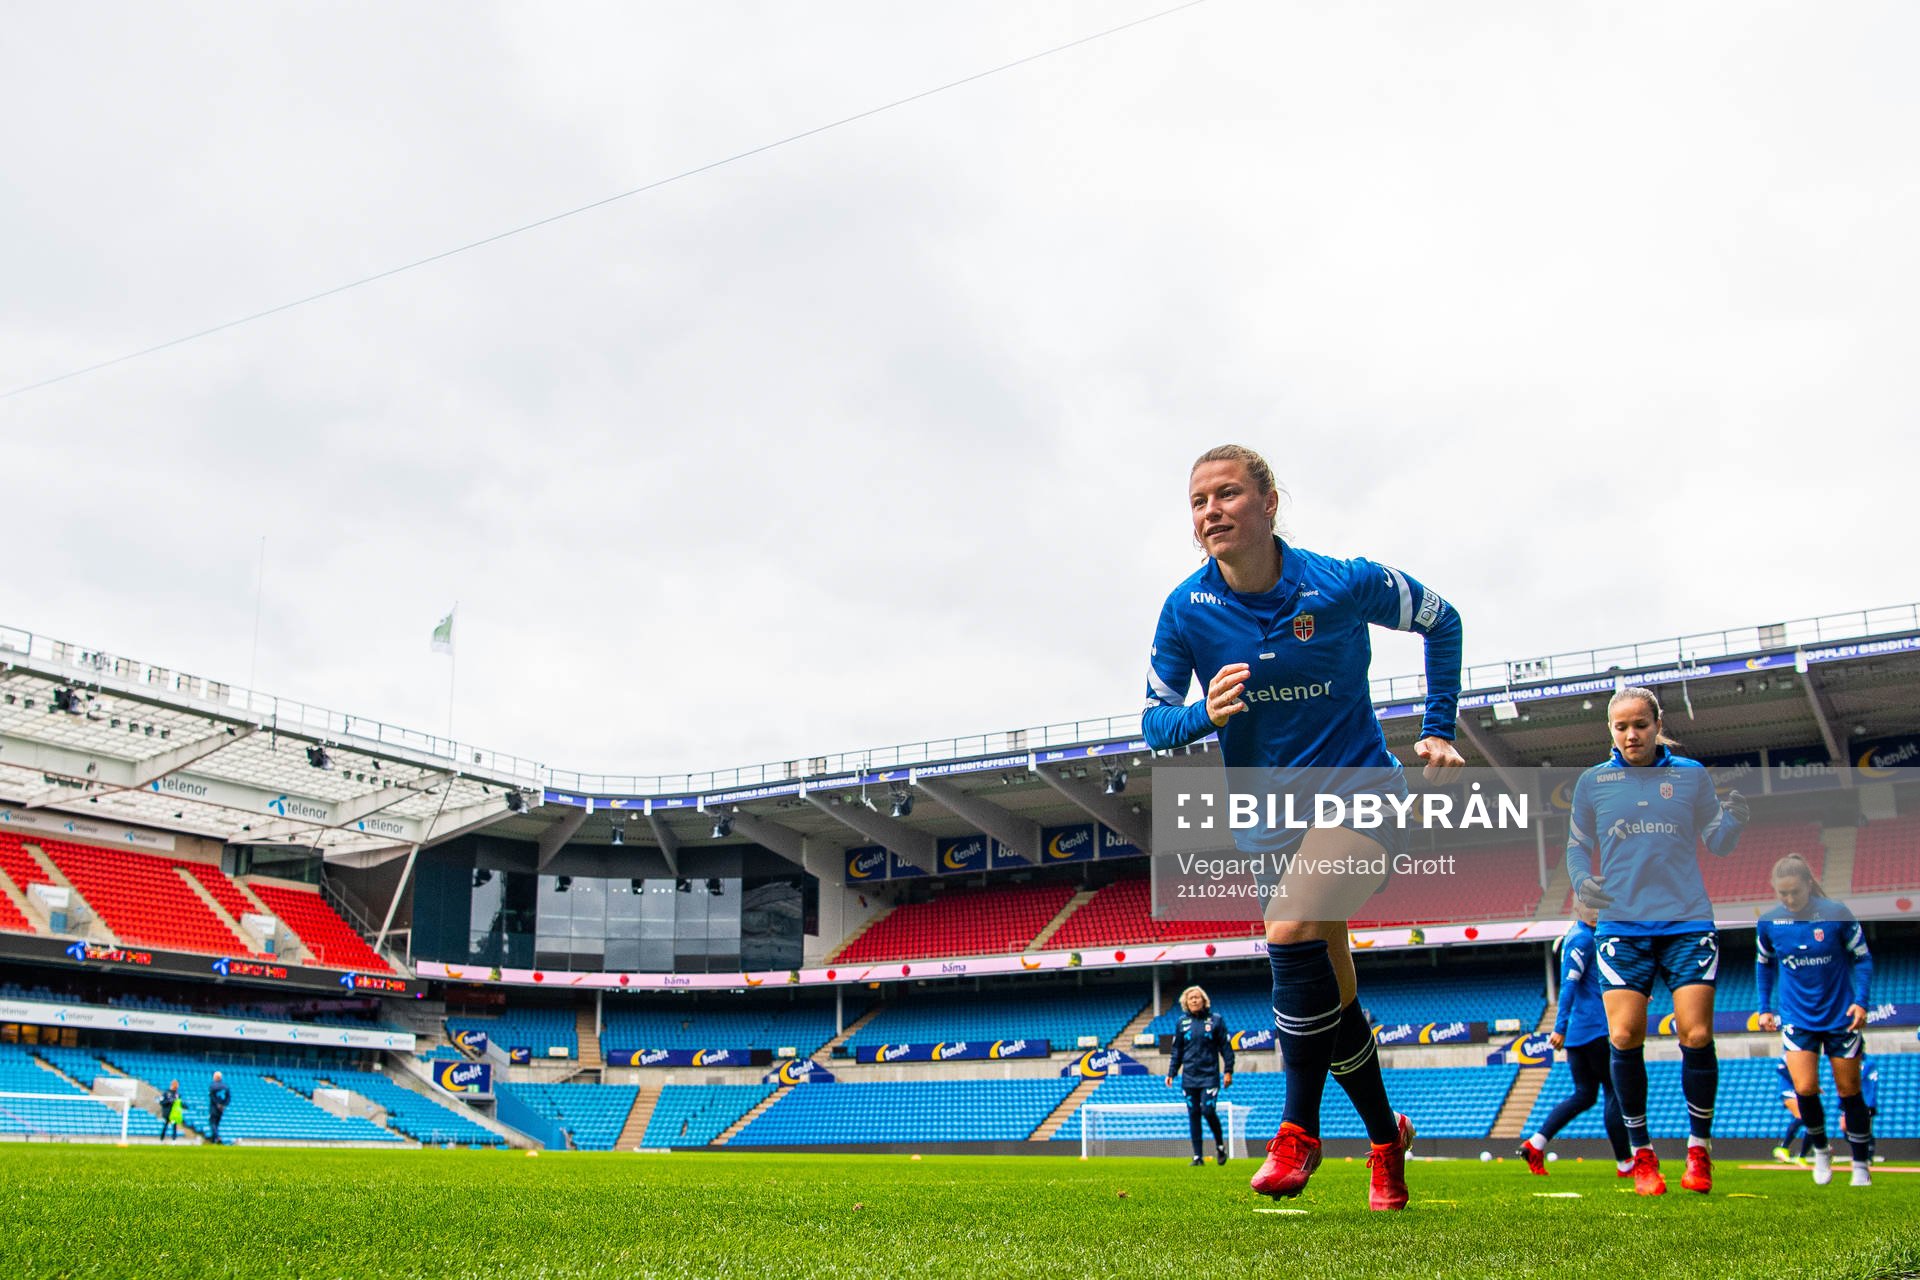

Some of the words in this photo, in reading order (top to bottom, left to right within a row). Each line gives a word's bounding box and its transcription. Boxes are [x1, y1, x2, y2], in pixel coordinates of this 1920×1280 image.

[1543, 685, 1560, 696] OG
[1561, 678, 1615, 694] AKTIVITET
[1624, 675, 1643, 685] GIR
[1245, 680, 1332, 702] telenor
[1873, 744, 1919, 768] Bendit
[915, 765, 949, 776] OPPLEV
[1597, 772, 1617, 783] KIWI
[162, 777, 208, 797] telenor
[287, 802, 328, 821] telenor
[1625, 819, 1679, 834] telenor
[1059, 830, 1089, 852] Bendit
[858, 852, 885, 871] Bendit
[953, 841, 981, 863] Bendit
[1795, 954, 1833, 966] telenor
[1867, 1003, 1897, 1024] endit
[1240, 1029, 1273, 1049] Bendit
[1378, 1022, 1413, 1044] Bendit
[1430, 1019, 1467, 1042] Bendit
[885, 1043, 910, 1061] Bendit
[940, 1042, 967, 1059] Bendit
[998, 1040, 1026, 1058] Bendit
[1523, 1034, 1556, 1057] Bend
[641, 1048, 669, 1065] Bendit
[702, 1049, 729, 1066] Bendit
[1090, 1049, 1121, 1071] Bendit
[453, 1064, 482, 1084] Bendit
[789, 1060, 815, 1078] Bendit
